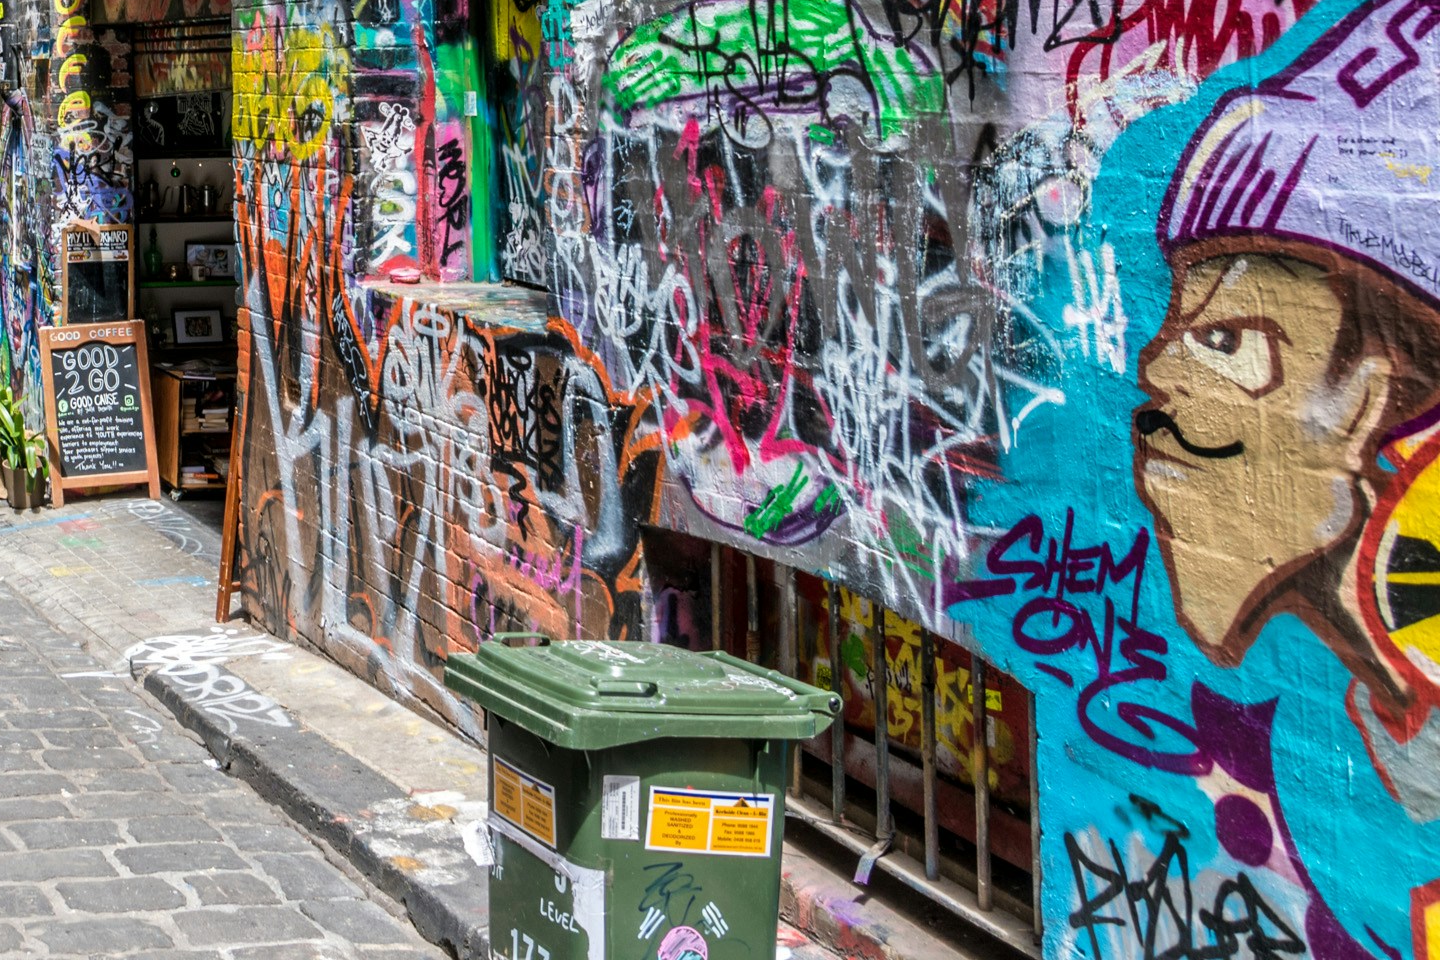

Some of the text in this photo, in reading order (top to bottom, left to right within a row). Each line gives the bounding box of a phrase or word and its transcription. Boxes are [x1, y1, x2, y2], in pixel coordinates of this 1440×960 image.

[49, 327, 133, 342] GOOD COFFEE
[62, 345, 119, 371] GOOD
[65, 368, 120, 395] 2 GO
[70, 392, 119, 409] GOOD CAUSE
[115, 416, 134, 426] training
[75, 460, 97, 470] Thank
[540, 897, 579, 934] LEVEL
